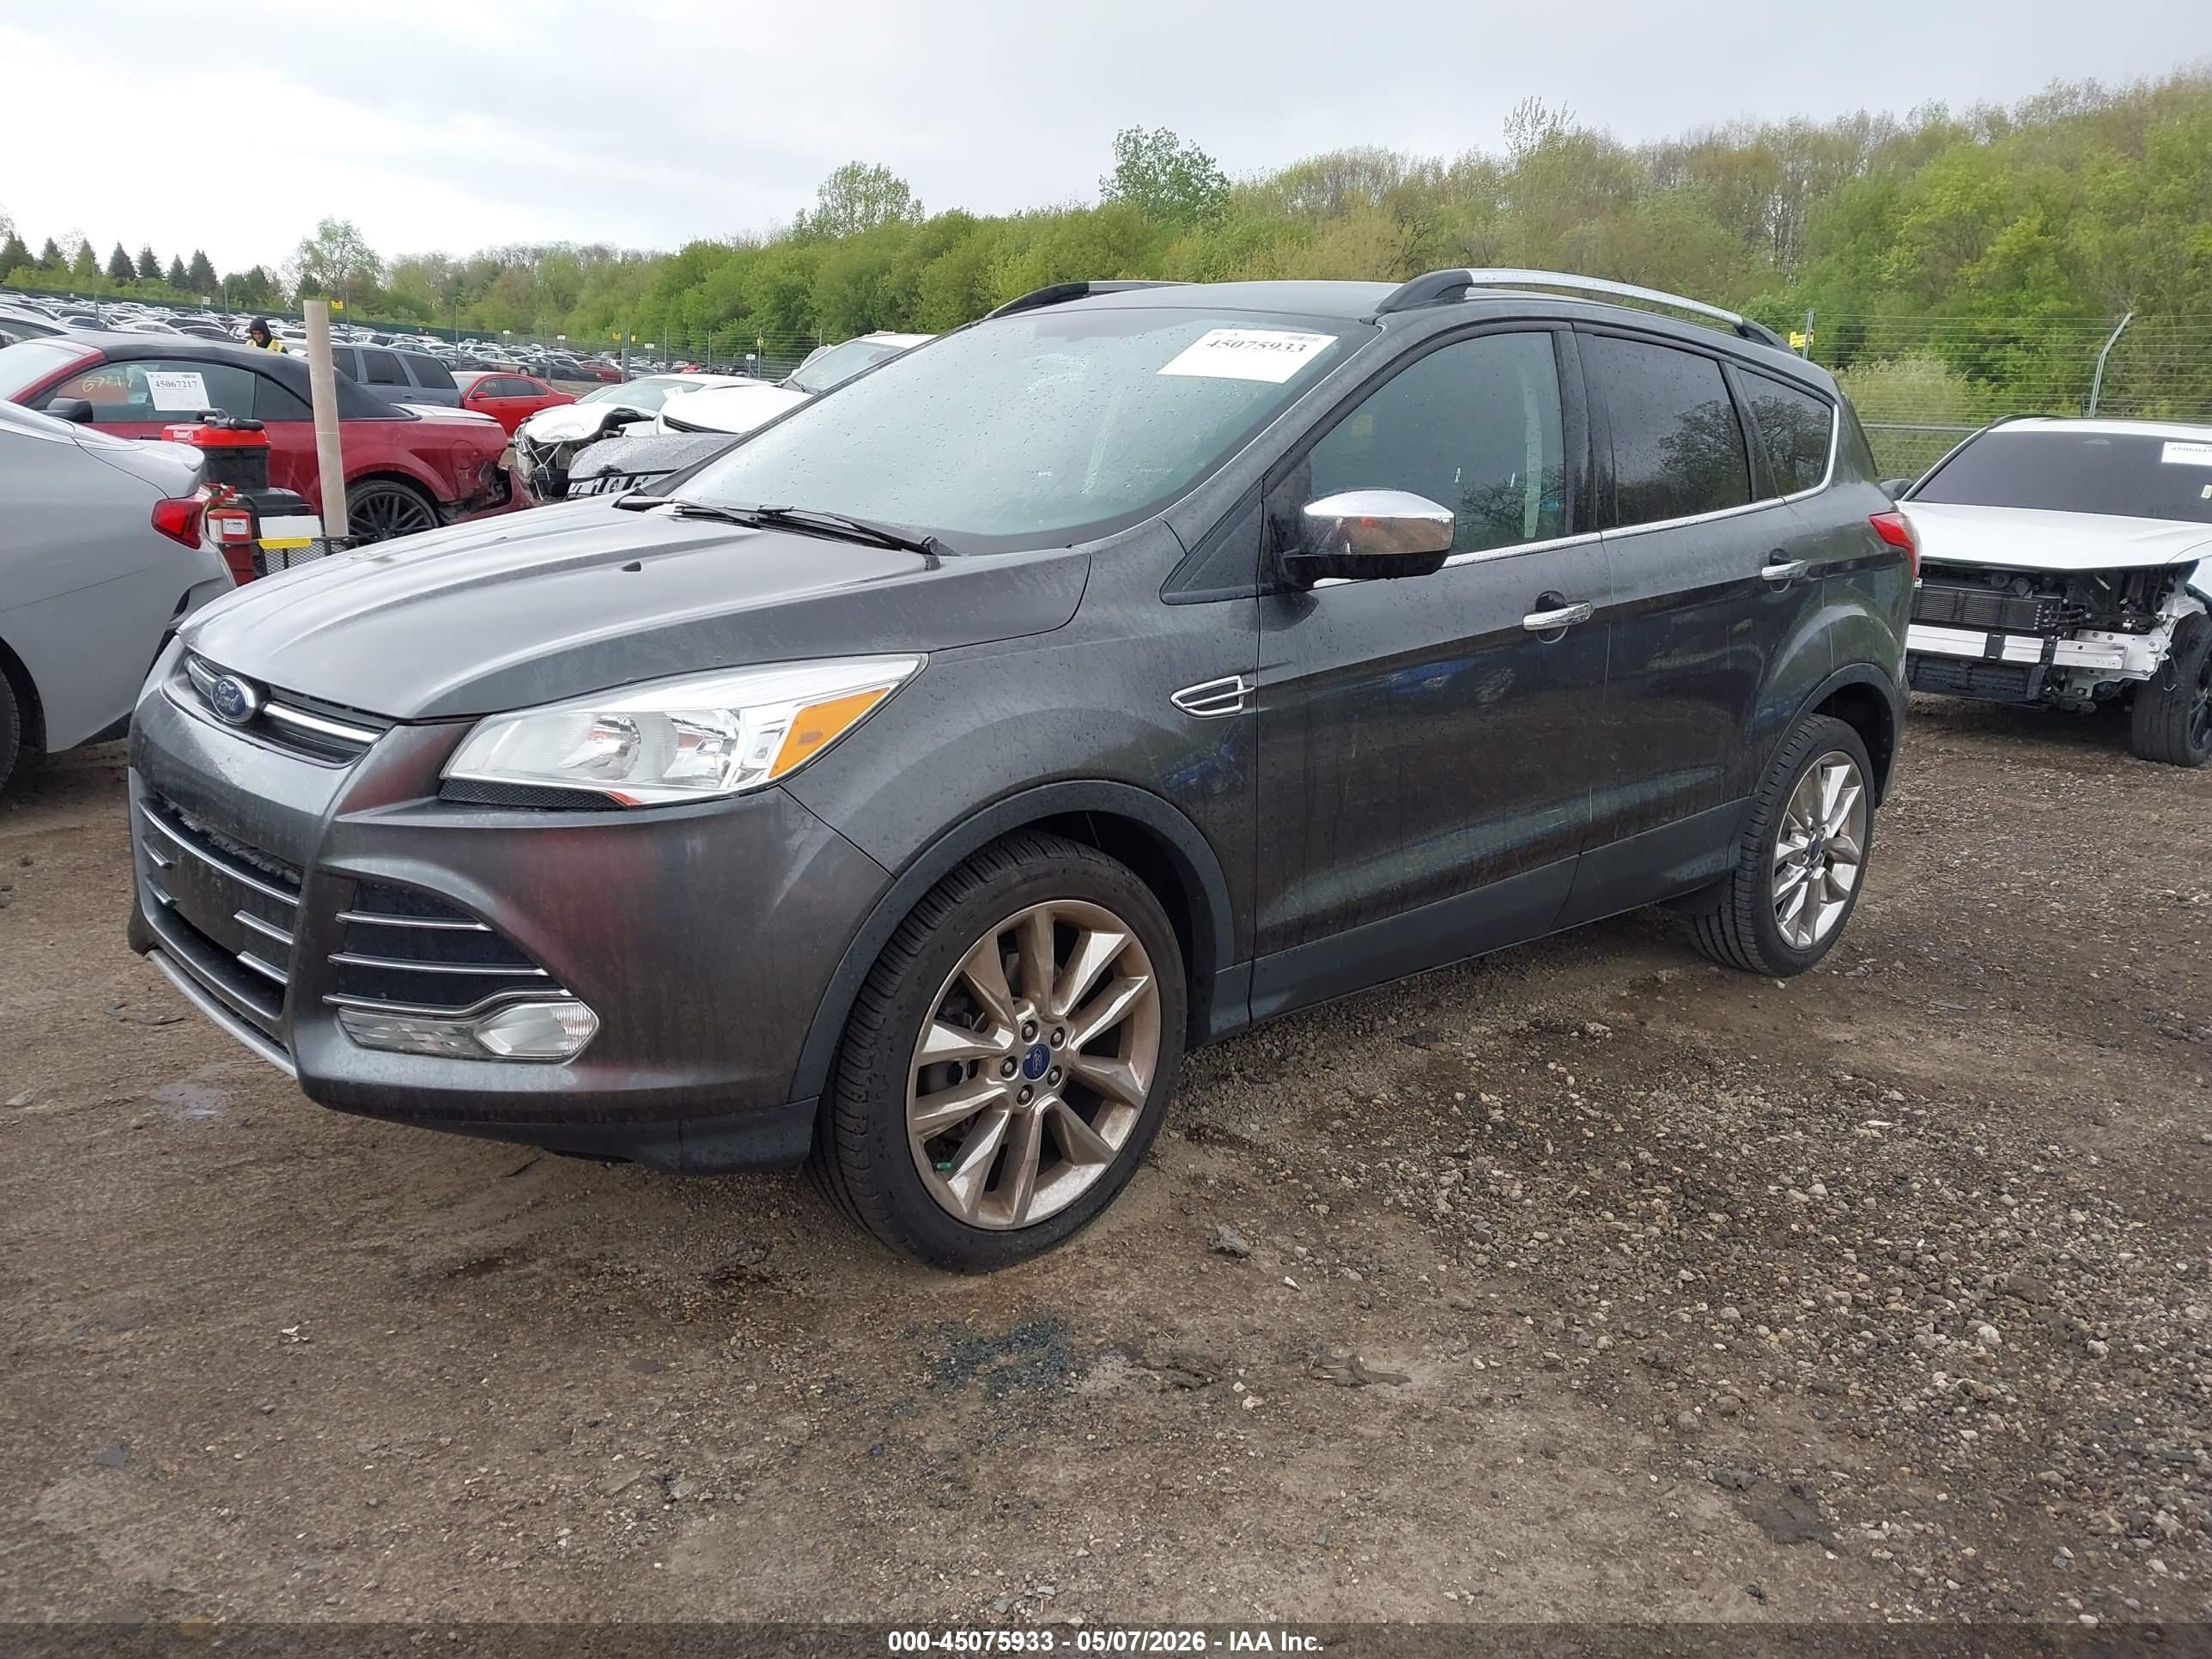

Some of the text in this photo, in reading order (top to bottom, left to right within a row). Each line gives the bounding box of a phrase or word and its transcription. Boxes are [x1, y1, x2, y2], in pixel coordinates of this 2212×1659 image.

[1206, 339, 1306, 352] 45075933
[155, 380, 198, 388] 45067217
[216, 681, 239, 712] Ford
